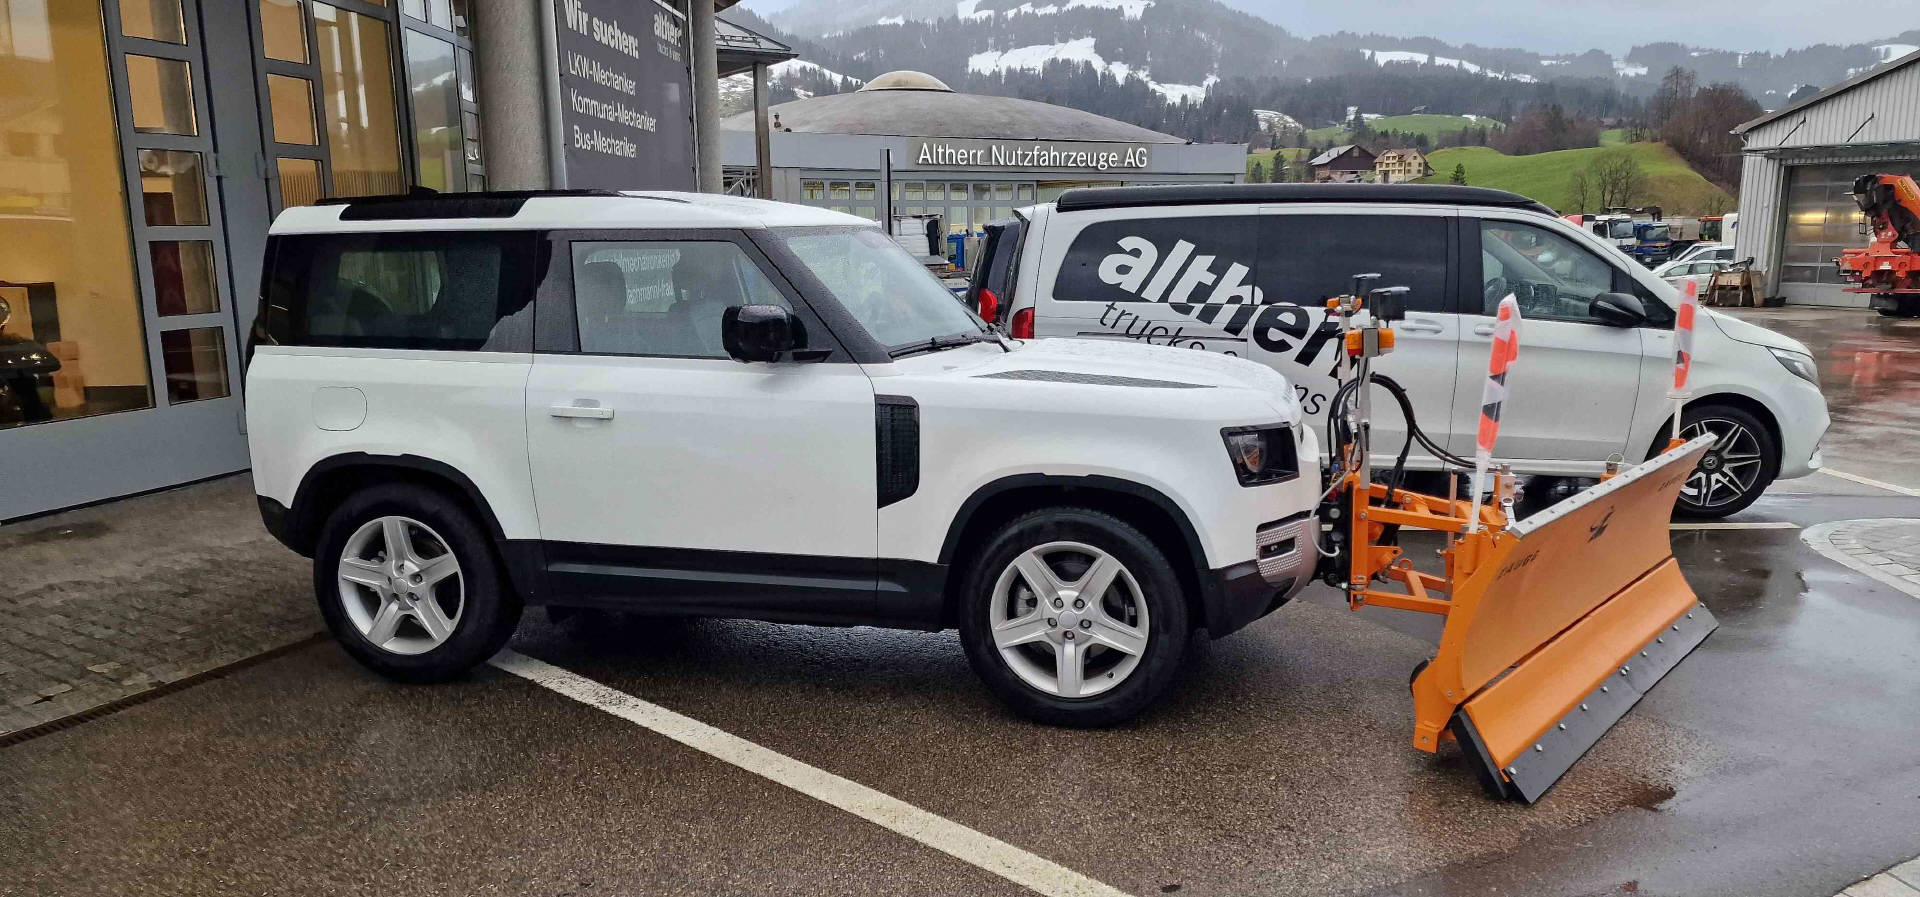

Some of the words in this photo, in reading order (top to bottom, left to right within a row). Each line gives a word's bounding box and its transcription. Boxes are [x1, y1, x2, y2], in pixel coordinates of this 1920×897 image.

[564, 0, 588, 36] Wir
[592, 17, 639, 59] suchen:
[568, 50, 636, 96] LKW-Mechaniker
[571, 88, 657, 133] Kommunal-Mechaniker
[574, 125, 637, 159] Bus-Mechaniker
[918, 142, 984, 165] Altherr
[991, 145, 1118, 170] Nutzfahrzeuge
[1125, 147, 1147, 168] AG
